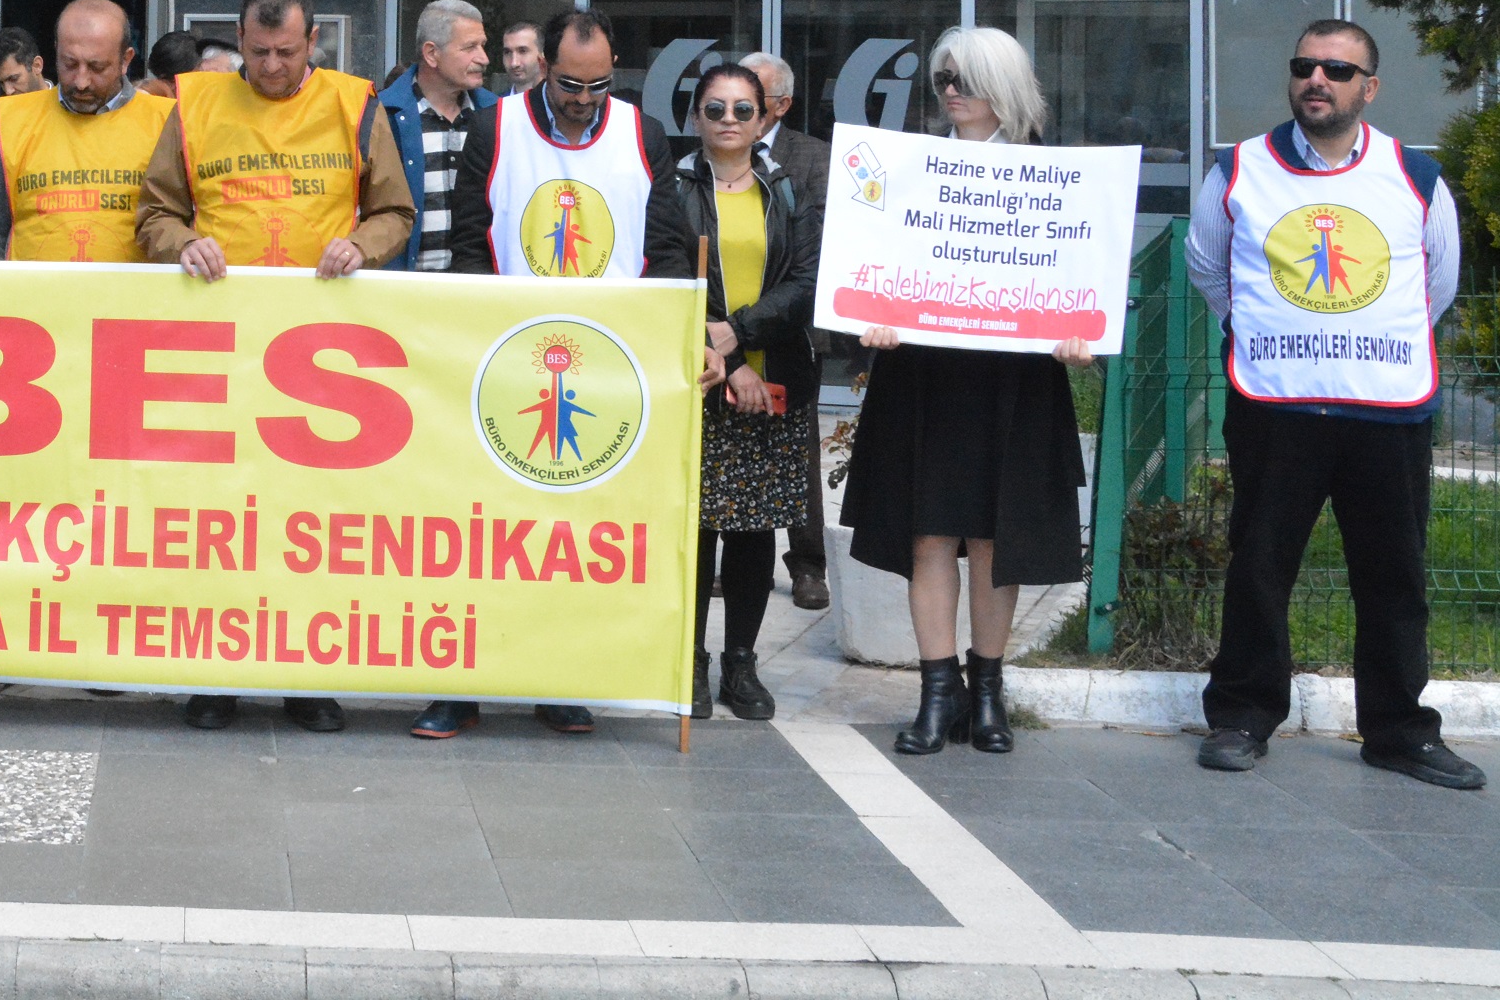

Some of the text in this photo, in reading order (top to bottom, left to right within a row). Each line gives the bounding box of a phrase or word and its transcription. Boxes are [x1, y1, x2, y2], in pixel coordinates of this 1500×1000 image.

[925, 155, 1081, 190] Hazine ve Maliye
[40, 192, 95, 211] ONURLU
[227, 178, 326, 199] ONURLU SESİ
[560, 195, 575, 206] BES
[938, 185, 1062, 215] Bakanlığı'nda
[904, 209, 1092, 240] Mali Hizmetler Sınıfı
[1314, 218, 1334, 229] BES
[932, 241, 1057, 267] oluşturulsun!
[1273, 269, 1385, 310] BÜRO EMEKÇİLERİ SENDİKASI
[918, 313, 1018, 332] BÜRO EMEKÇİLERİ SENDİKASI
[546, 353, 568, 364] BES
[1250, 328, 1412, 366] BÜRO EMEKÇİLERİ SENDİKASI
[485, 417, 631, 481] BÜRO EMEKÇİLERİ SENDİKASI
[283, 502, 648, 584] SENDİKASI
[28, 587, 77, 654] İL
[97, 596, 478, 669] TEMSİLCİLİĞİ
